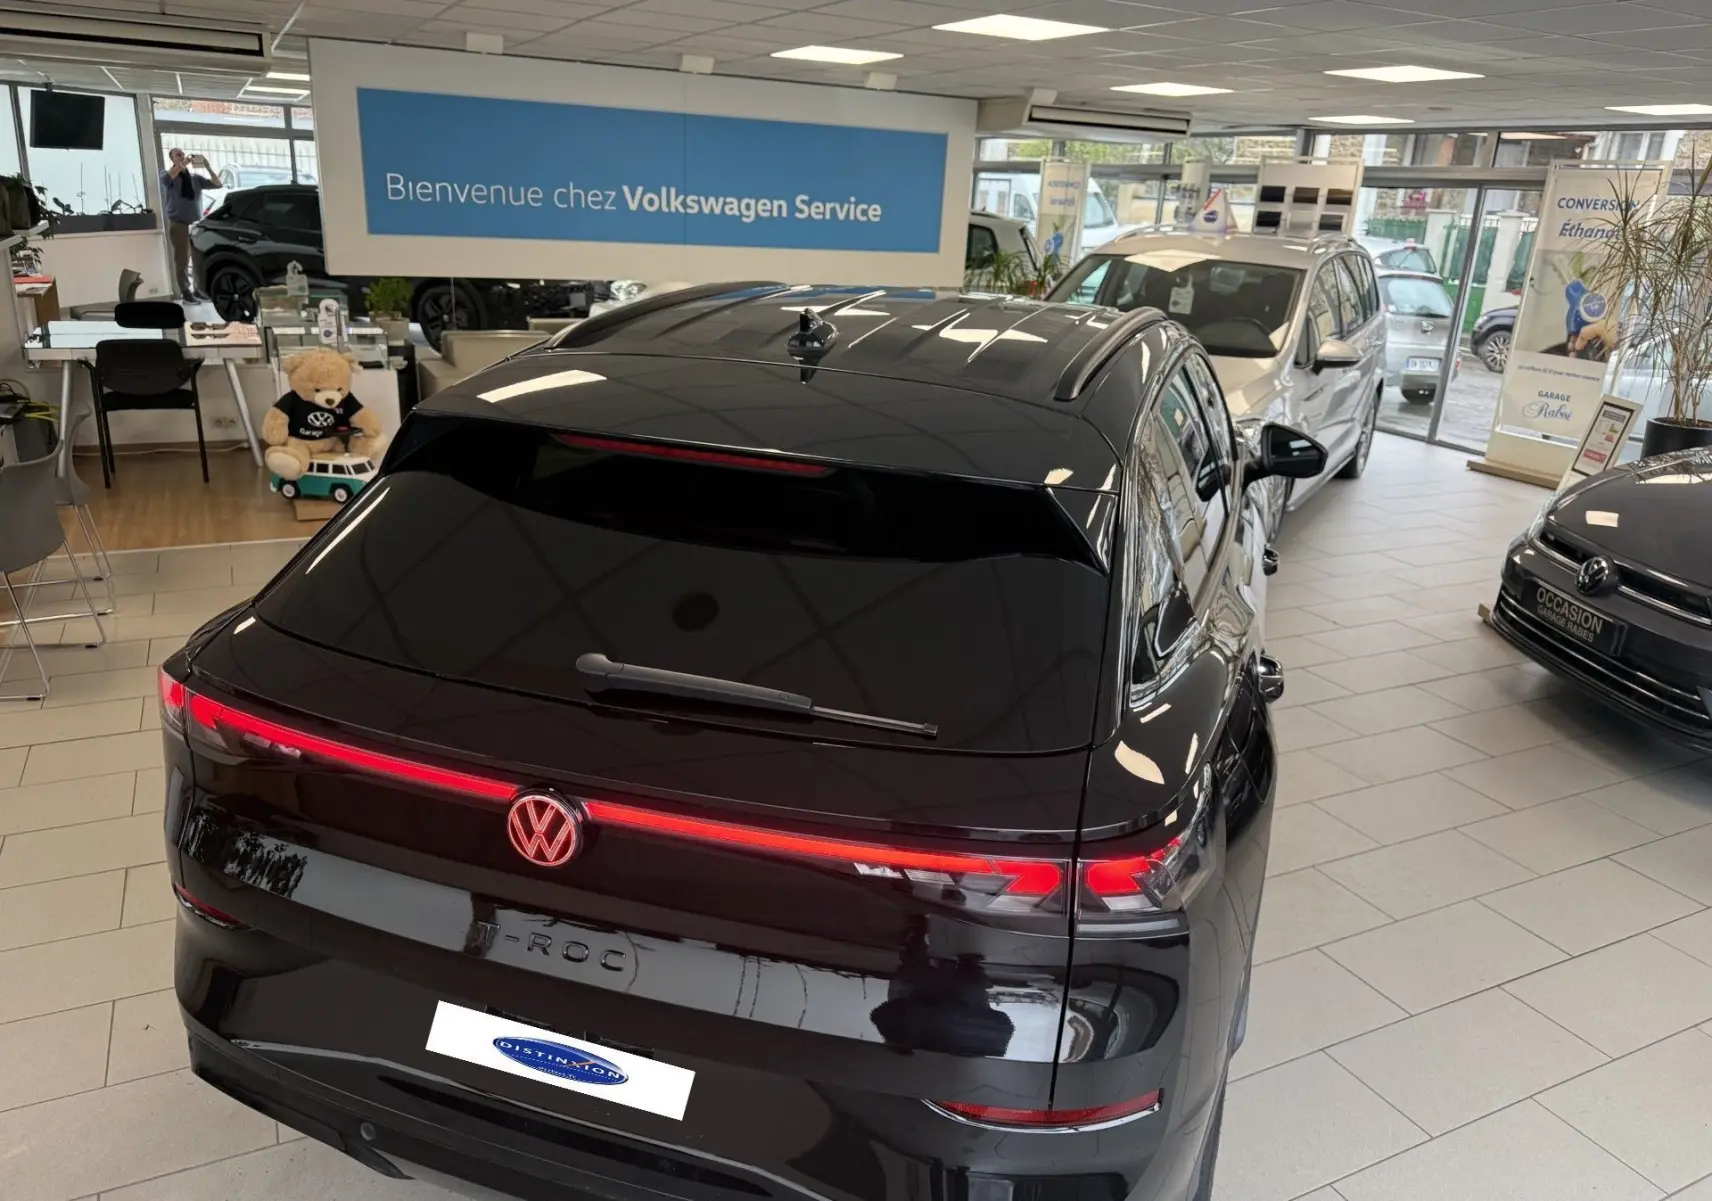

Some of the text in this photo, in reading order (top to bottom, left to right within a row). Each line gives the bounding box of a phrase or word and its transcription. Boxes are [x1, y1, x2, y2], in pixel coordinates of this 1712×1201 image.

[386, 172, 883, 223] Bienvenue chez Volkswagen Service
[1538, 390, 1572, 402] GARAGE
[1536, 587, 1603, 634] OCCASION
[1537, 604, 1594, 643] GARAGE RABES
[477, 920, 628, 972] T-ROC
